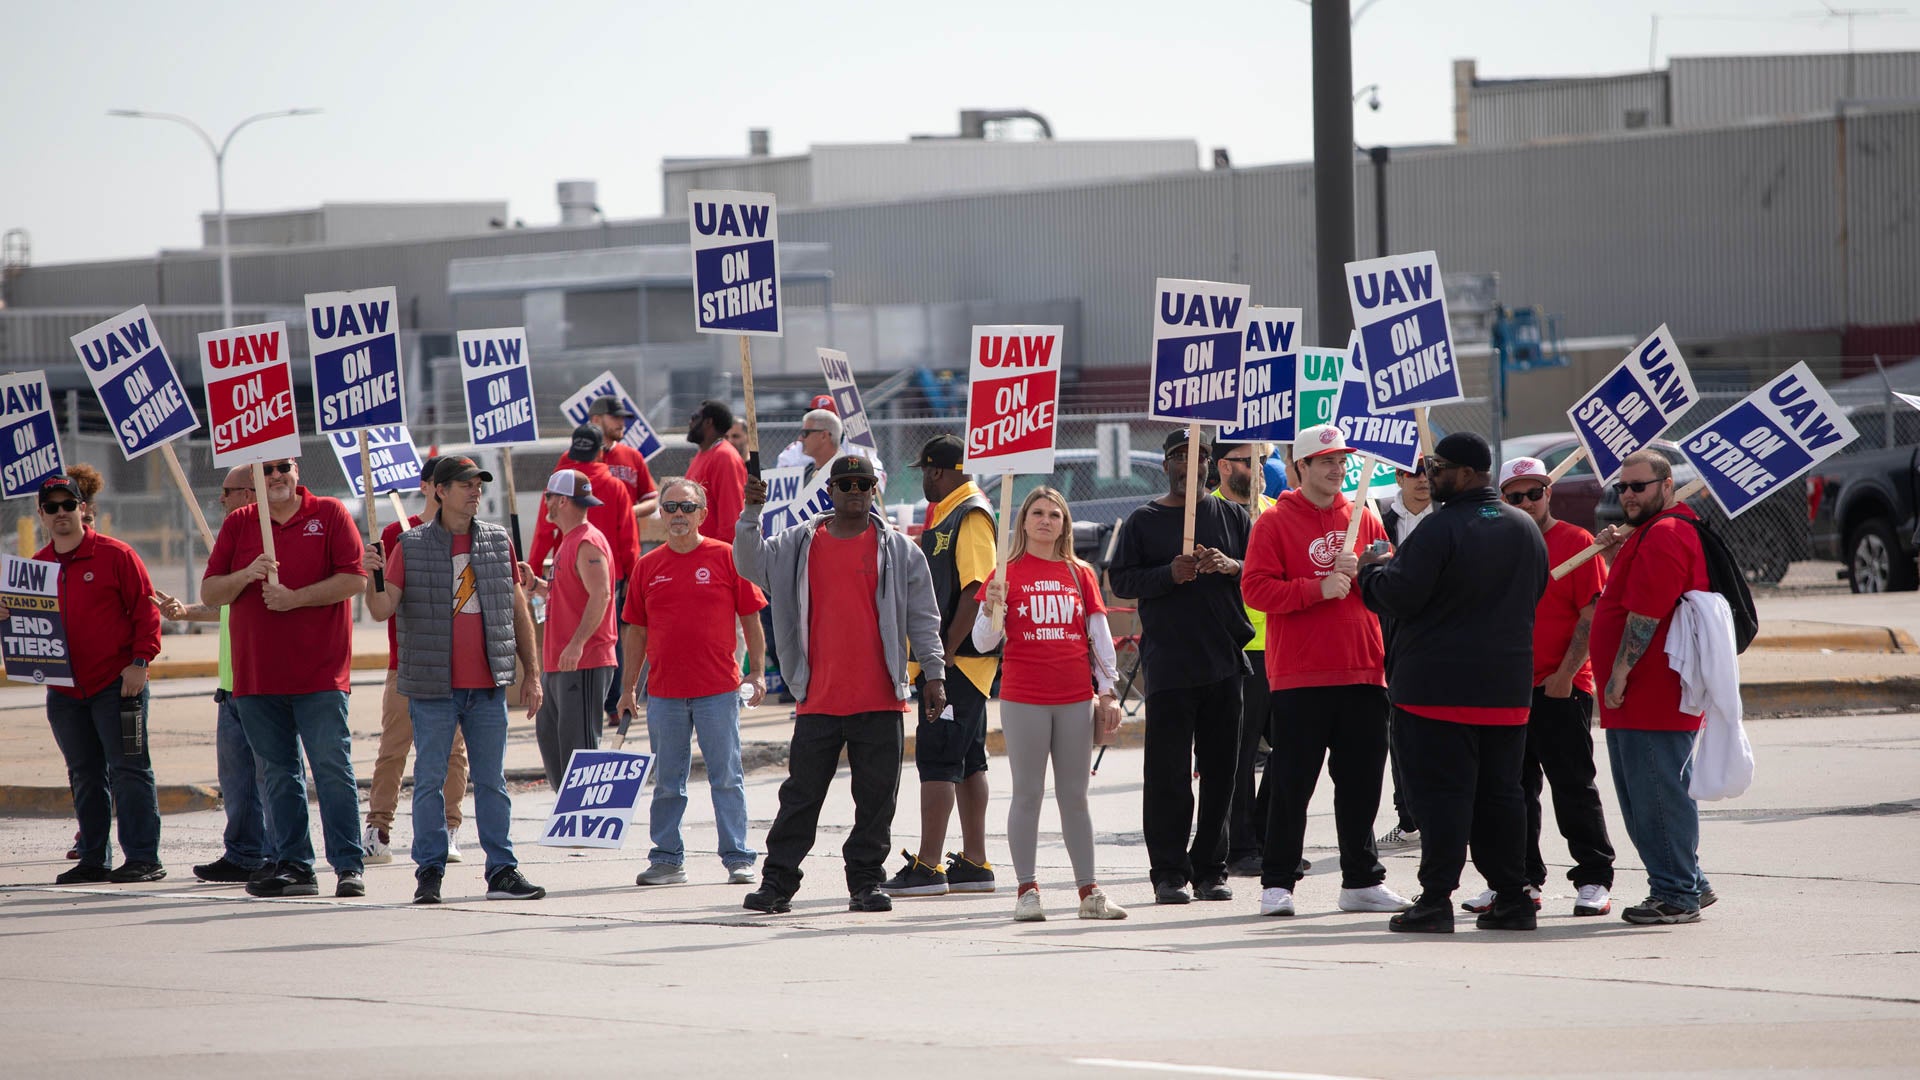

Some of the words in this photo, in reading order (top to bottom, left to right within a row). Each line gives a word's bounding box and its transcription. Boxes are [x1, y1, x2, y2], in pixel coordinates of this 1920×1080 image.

[694, 202, 769, 238] UAW
[721, 249, 750, 285] ON
[702, 278, 774, 323] STRIKE
[1353, 264, 1432, 309] UAW
[312, 300, 389, 339] UAW
[1161, 292, 1242, 329] UAW
[80, 318, 151, 372] UAW
[207, 331, 279, 369] UAW
[463, 338, 521, 368] UAW
[979, 335, 1055, 368] UAW
[1246, 321, 1295, 352] AW
[1390, 314, 1423, 356] ON
[342, 346, 372, 384] ON
[821, 356, 851, 383] UAW
[1183, 340, 1215, 374] ON
[1374, 340, 1451, 403] STRIKE
[123, 365, 153, 405] ON
[232, 374, 263, 411] ON
[487, 375, 511, 406] ON
[1158, 368, 1236, 411] STRIKE
[1244, 364, 1271, 398] ON
[1640, 336, 1689, 415] UAW
[119, 380, 182, 449] STRIKE
[322, 370, 397, 426] STRIKE
[995, 378, 1028, 416] ON
[1616, 391, 1650, 426] ON
[1769, 374, 1843, 451] UAW
[214, 390, 292, 451] STRIKE
[474, 397, 531, 440] STRIKE
[969, 400, 1054, 456] STRIKE
[1339, 416, 1417, 446] STRIKE
[1578, 397, 1640, 462] STRIKE
[13, 422, 37, 455] ON
[1739, 426, 1787, 460] ON
[4, 442, 59, 491] STRIKE
[369, 448, 394, 468] ON
[1688, 431, 1777, 496] STRIKE
[8, 559, 47, 592] UAW
[1021, 584, 1034, 593] We
[1034, 580, 1061, 592] STAND
[2, 596, 37, 609] STAND
[41, 600, 55, 610] UP
[1030, 595, 1075, 624] UAW
[10, 615, 53, 635] END
[1023, 631, 1035, 641] We
[1036, 628, 1065, 640] STRIKE
[4, 636, 65, 657] TIERS
[567, 759, 645, 789] STRIKE
[580, 783, 614, 807] ON
[547, 815, 624, 841] UAW
